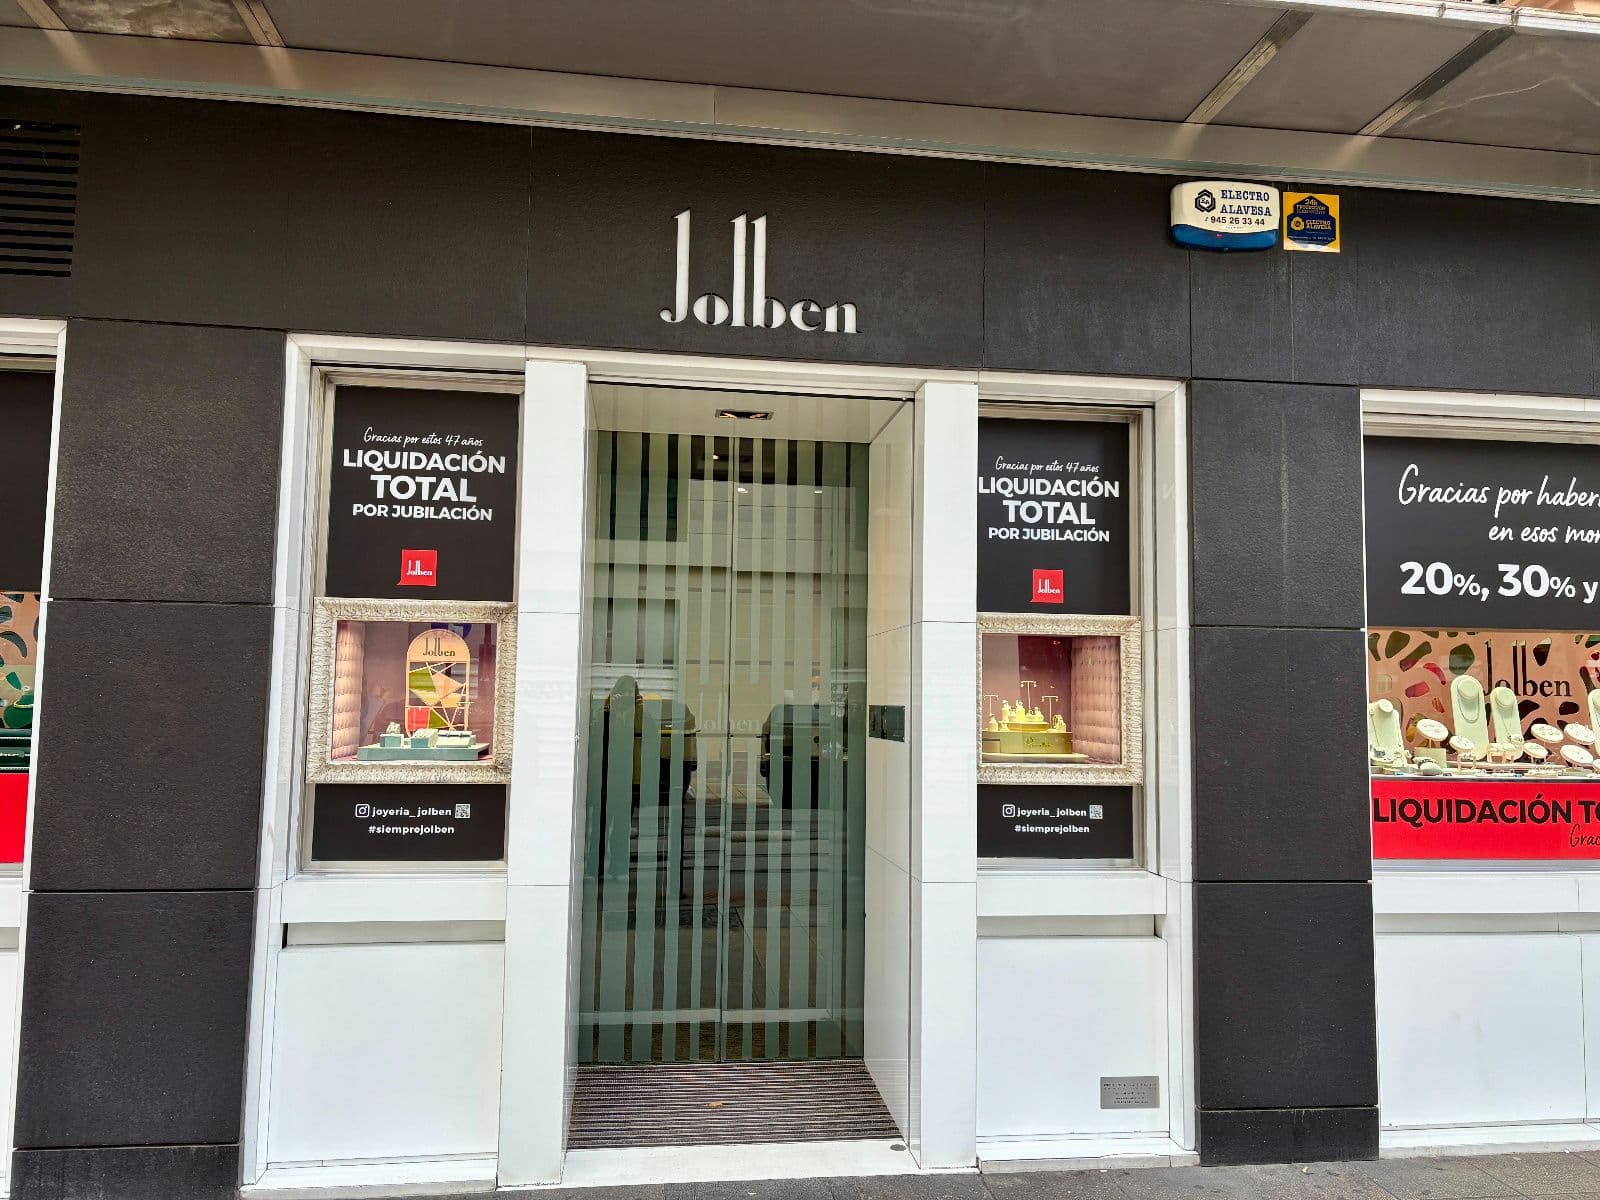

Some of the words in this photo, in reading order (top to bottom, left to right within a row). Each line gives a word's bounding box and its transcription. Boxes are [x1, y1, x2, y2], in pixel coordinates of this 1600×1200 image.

[1220, 190, 1269, 201] ELECTRO
[1220, 204, 1272, 216] ALAVESA
[1210, 216, 1227, 224] 945
[1229, 217, 1240, 225] 26
[659, 208, 863, 333] Jolben
[363, 426, 402, 443] Gracias
[403, 434, 420, 448] por
[421, 433, 442, 446] estos
[445, 435, 460, 447] 47
[461, 437, 484, 447] años
[343, 448, 506, 474] LIQUIDACIÓN
[995, 455, 1029, 470] Gracias
[1030, 463, 1044, 475] por
[1045, 460, 1063, 472] estos
[1066, 462, 1079, 473] 47
[1080, 463, 1100, 473] años
[370, 474, 477, 503] TOTAL
[978, 475, 1120, 498] LIQUIDACIÓN
[1398, 463, 1490, 505] Gracias
[1494, 486, 1533, 518] por
[1536, 474, 1600, 508] haber
[352, 503, 389, 517] POR
[391, 504, 493, 522] JUBILACIÓN
[1002, 500, 1096, 525] TOTAL
[988, 527, 1020, 540] POR
[1022, 527, 1110, 543] JUBILACIÓN
[1488, 525, 1514, 541] en
[1520, 525, 1559, 542] esos
[406, 560, 433, 576] Jolben
[1037, 579, 1061, 594] Jolben
[1399, 561, 1490, 602] 20%,
[1497, 563, 1576, 598] 30%
[1582, 581, 1599, 604] y
[422, 637, 456, 657] Jolben
[1373, 793, 1572, 828] LIQUIDACIÓN
[367, 825, 455, 836] #siemprejolben
[1014, 824, 1090, 835] #siemprejolben
